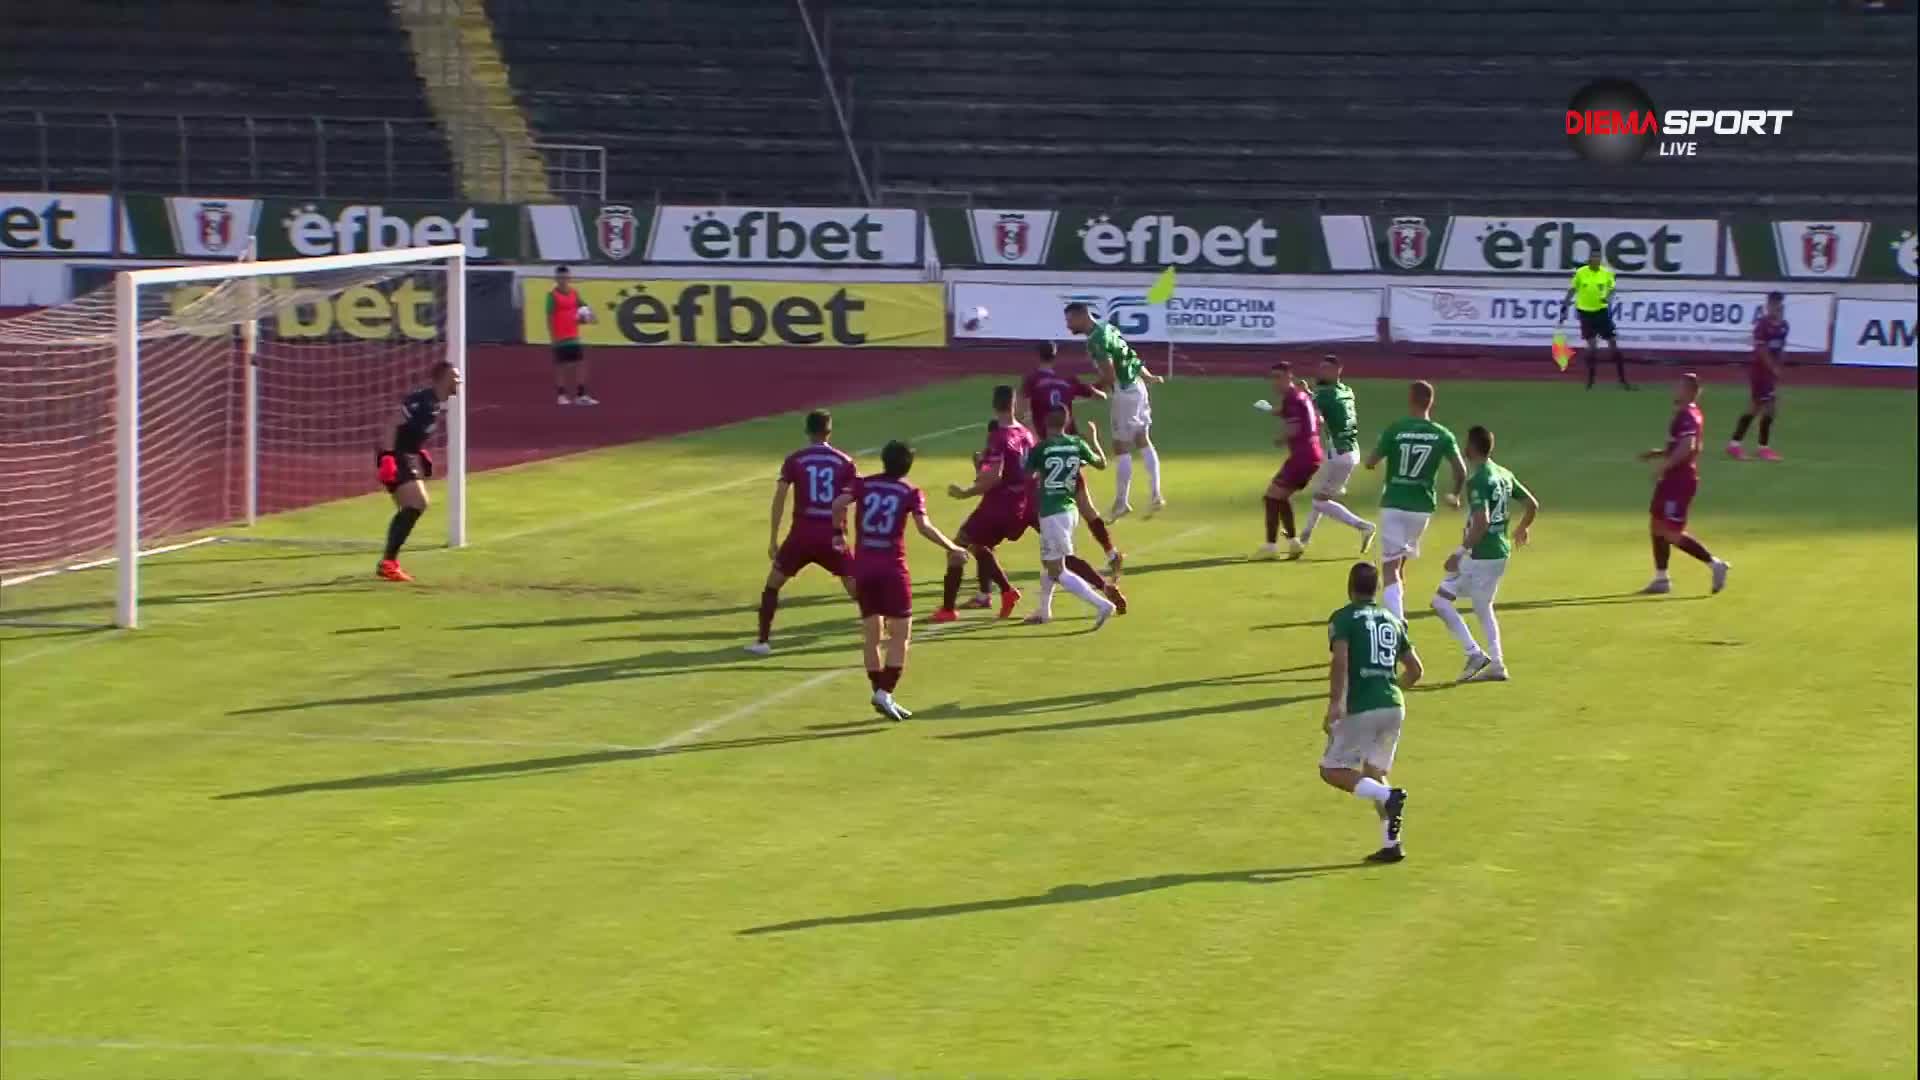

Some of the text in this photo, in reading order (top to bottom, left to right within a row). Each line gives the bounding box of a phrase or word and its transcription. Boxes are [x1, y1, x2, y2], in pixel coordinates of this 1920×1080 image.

[289, 204, 488, 258] efbet
[688, 211, 884, 260] efbet
[1083, 215, 1278, 267] efbet
[1482, 221, 1683, 272] efbet
[171, 273, 437, 339] ebet
[616, 284, 866, 345] efbet
[1166, 297, 1275, 313] EVROCHIM
[1166, 313, 1275, 328] GROUP LTD
[1491, 297, 1743, 324] ПЪТСЙ-ГАБРОВО
[806, 464, 834, 503] 13
[1044, 456, 1080, 489] 22
[1398, 443, 1433, 478] 17
[862, 492, 900, 536] 23
[1366, 620, 1399, 668] 19
